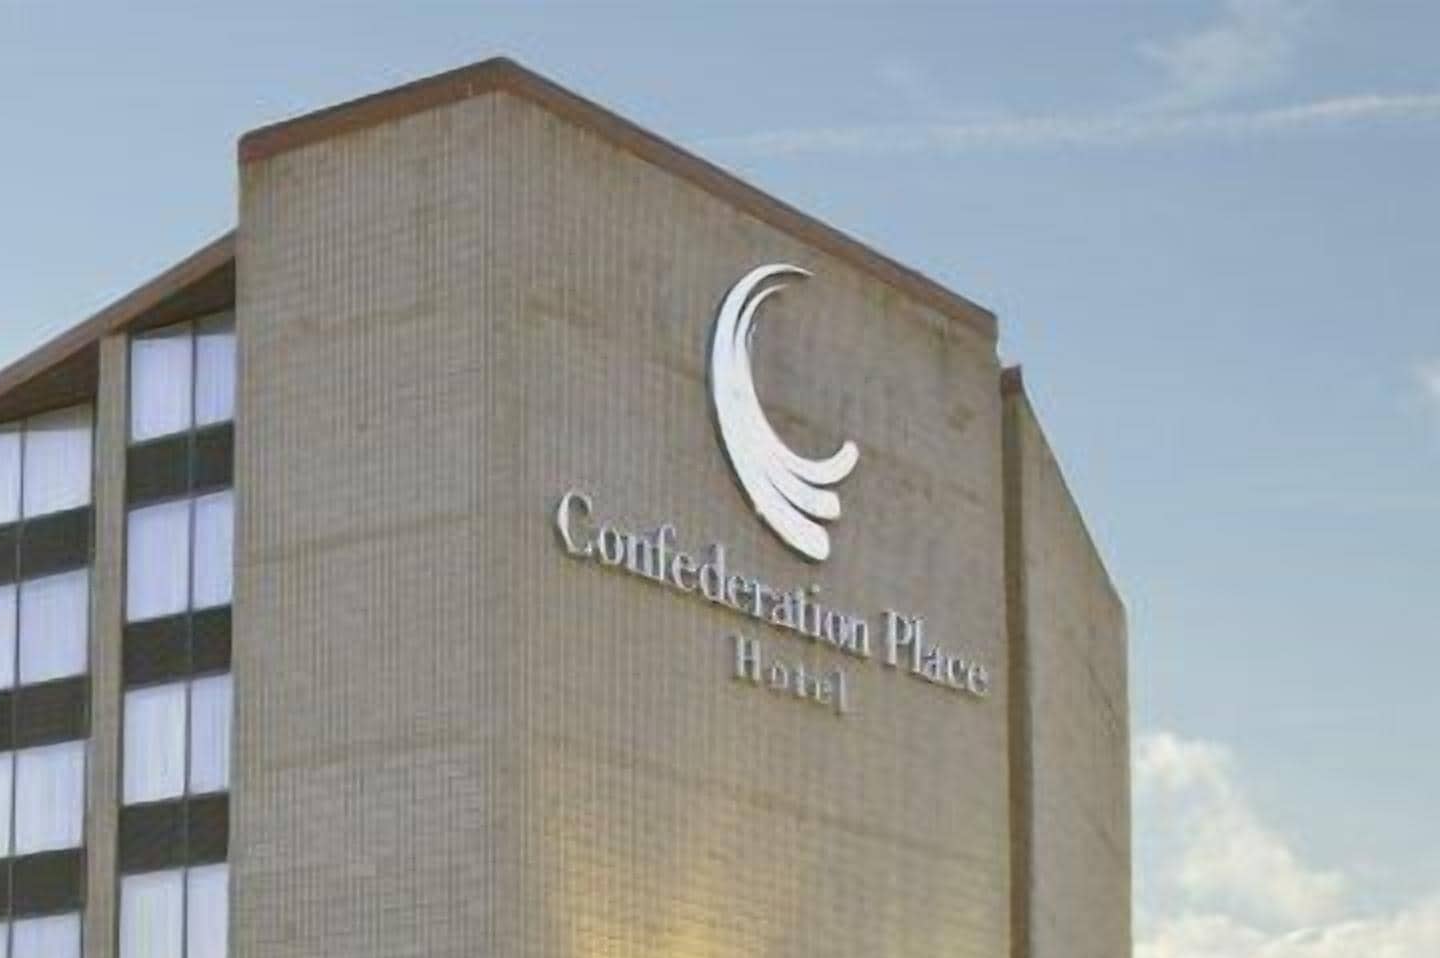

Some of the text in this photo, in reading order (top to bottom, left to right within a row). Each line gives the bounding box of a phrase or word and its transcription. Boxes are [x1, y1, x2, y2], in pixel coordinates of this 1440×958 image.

[556, 489, 991, 698] Confederation Place
[734, 634, 849, 714] Hotel
